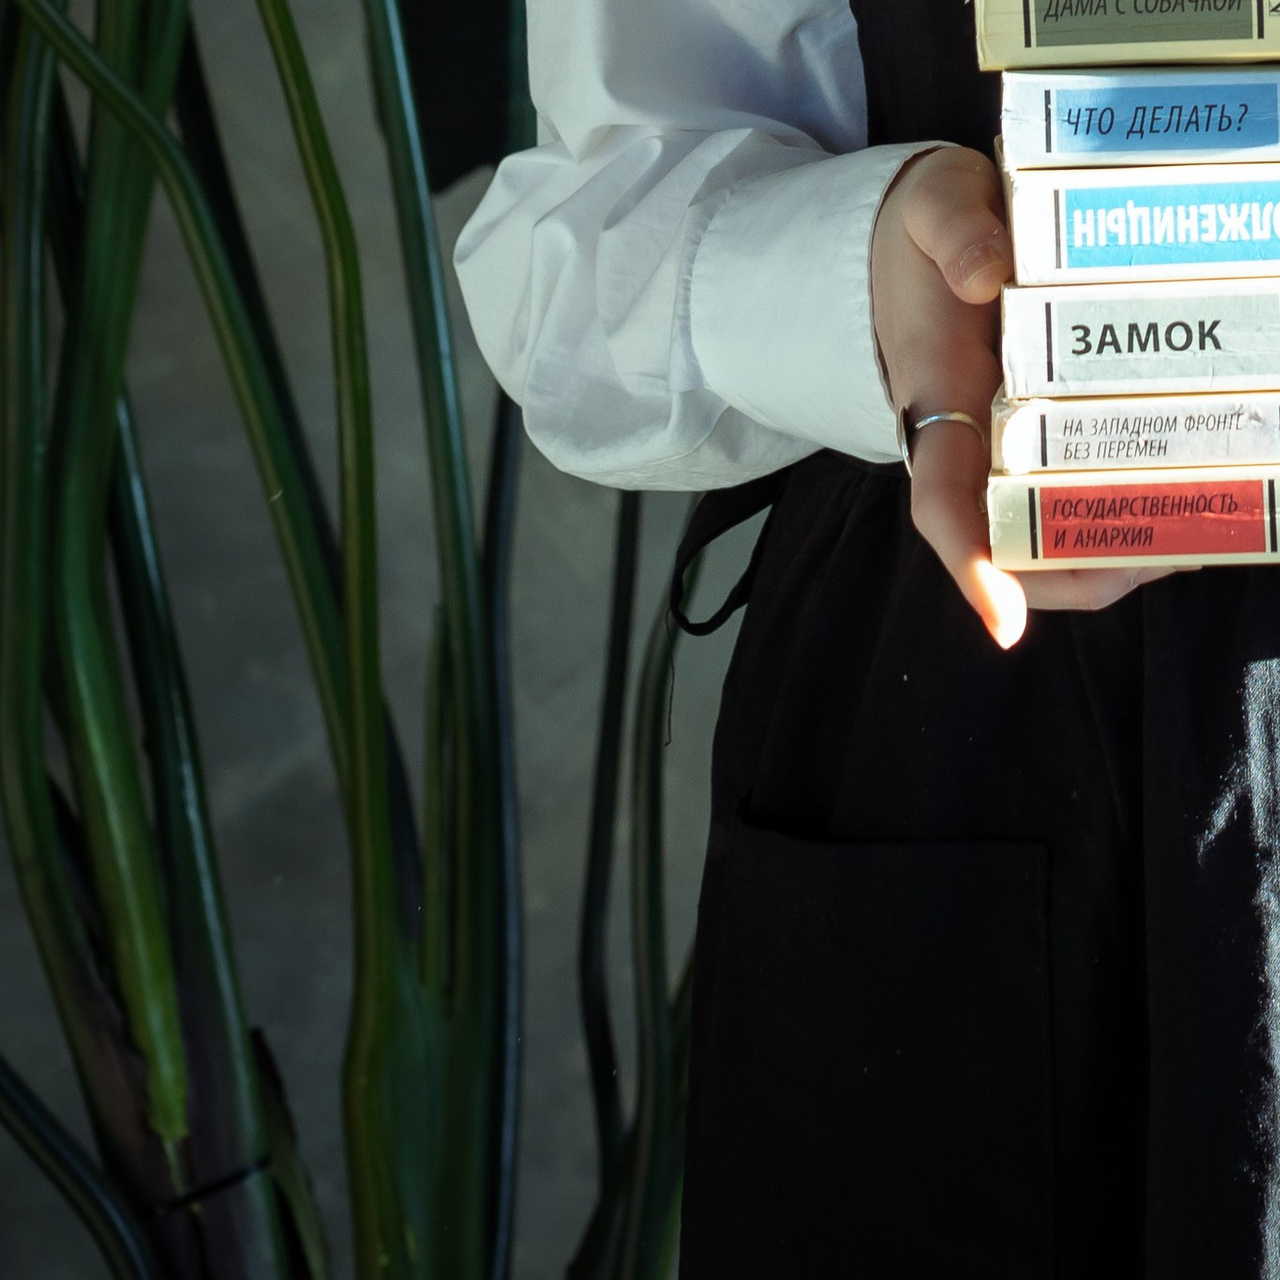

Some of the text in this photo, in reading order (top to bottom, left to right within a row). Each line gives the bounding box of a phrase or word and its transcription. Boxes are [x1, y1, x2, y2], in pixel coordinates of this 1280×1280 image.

[1067, 103, 1249, 140] ЧТО ДЕЛАТЬ?
[1071, 319, 1222, 355] ЗАМОК
[1063, 419, 1083, 436] НА
[1090, 416, 1178, 437] ЗАПАДНОМ
[1064, 439, 1168, 460] БЕЗ ПЕРЕМЕН
[1053, 493, 1238, 520] ГОСУДАРСТВЕННОСТЬ
[1054, 526, 1154, 549] И АНАРХИЯ
